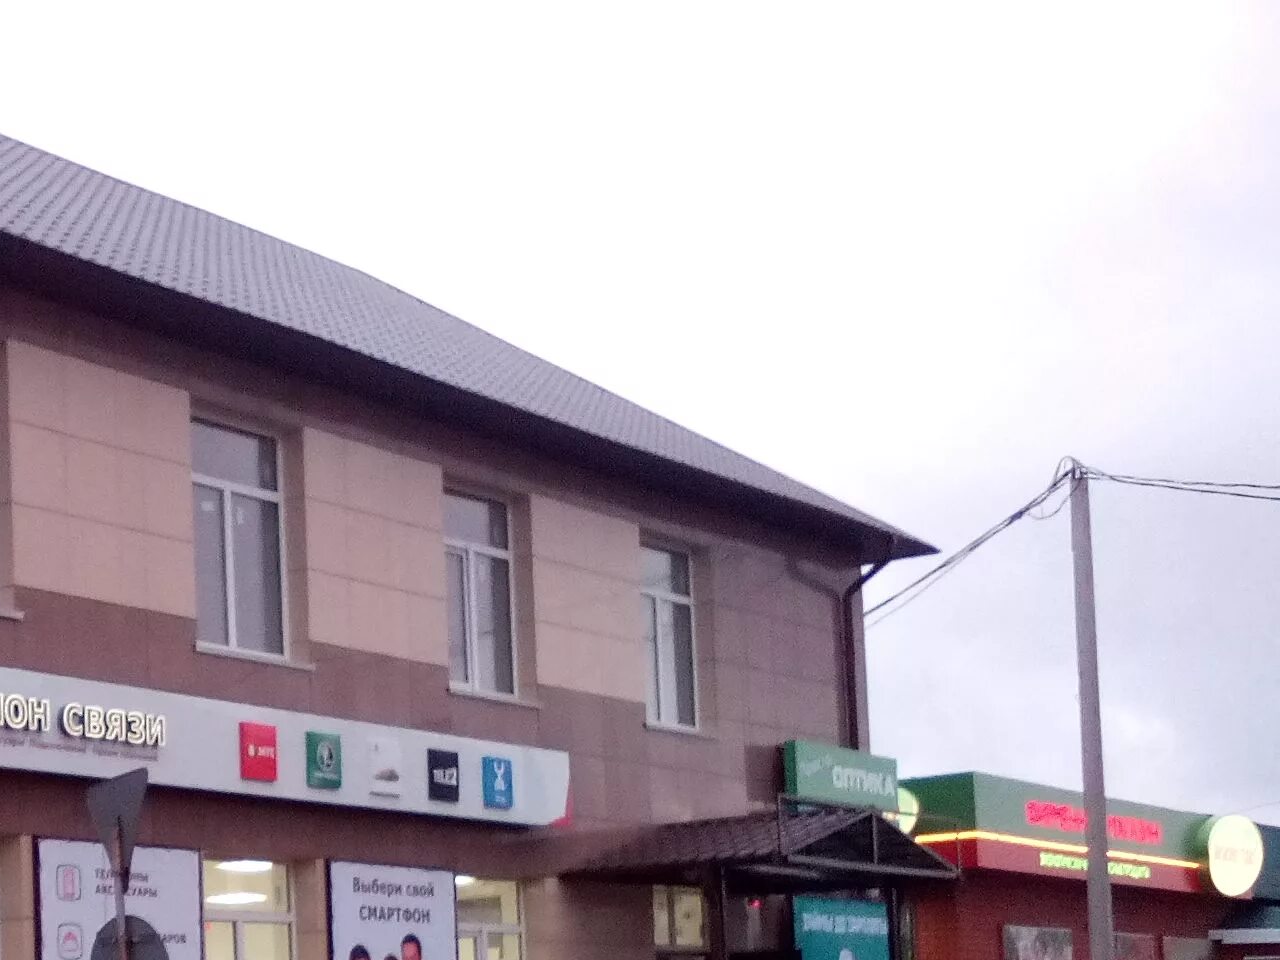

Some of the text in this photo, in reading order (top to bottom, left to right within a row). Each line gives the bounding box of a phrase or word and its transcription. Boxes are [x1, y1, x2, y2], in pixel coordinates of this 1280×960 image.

[61, 701, 167, 746] связи
[352, 877, 401, 898] Выбери
[359, 905, 431, 923] СМАРТФОН
